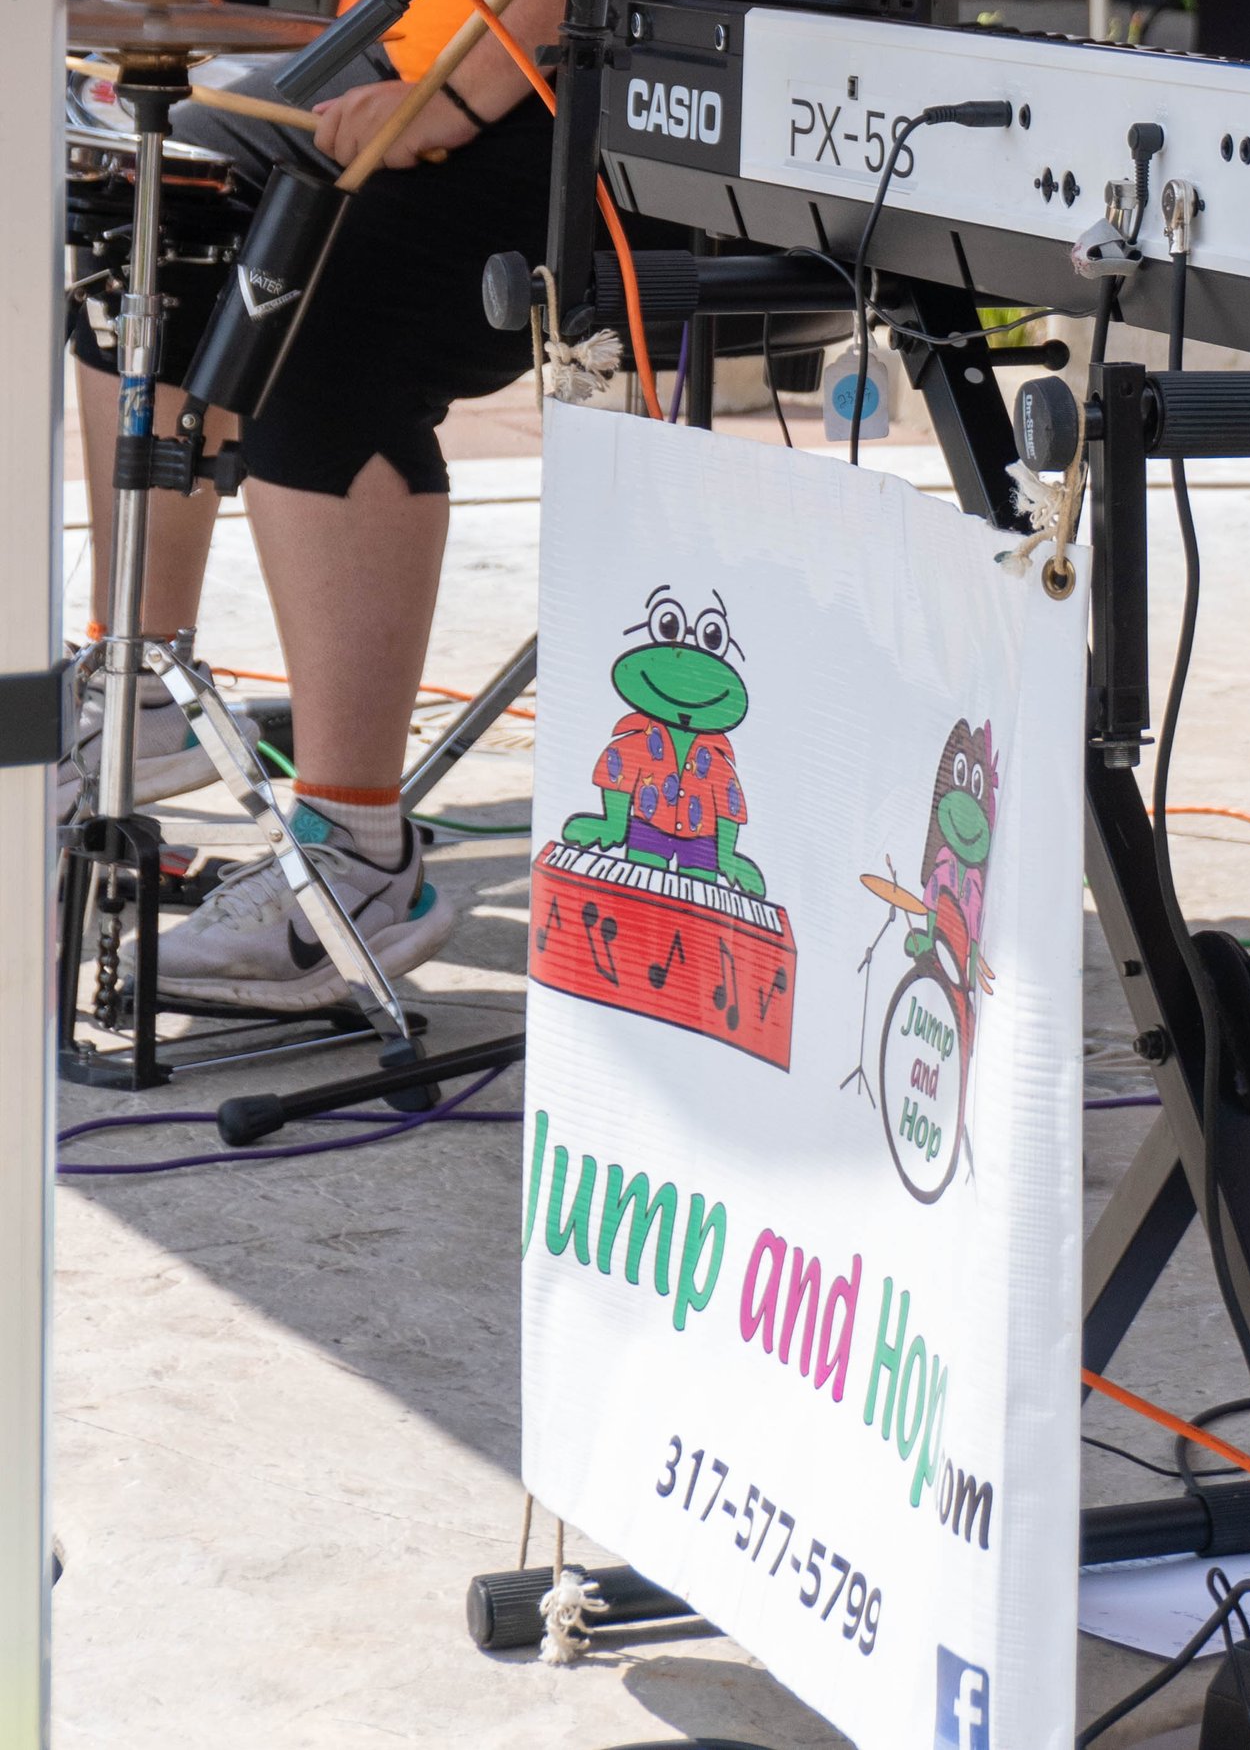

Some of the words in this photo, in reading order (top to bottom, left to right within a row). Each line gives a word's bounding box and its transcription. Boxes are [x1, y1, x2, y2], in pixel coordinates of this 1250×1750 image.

[626, 78, 723, 145] CASIO
[790, 97, 915, 179] PX-5S
[249, 270, 283, 296] VATER
[901, 996, 955, 1062] Jump
[910, 1057, 940, 1101] and
[899, 1096, 943, 1163] Hop
[521, 1109, 727, 1332] Jump
[739, 1227, 863, 1403] and
[655, 1434, 883, 1657] 317-577-5799
